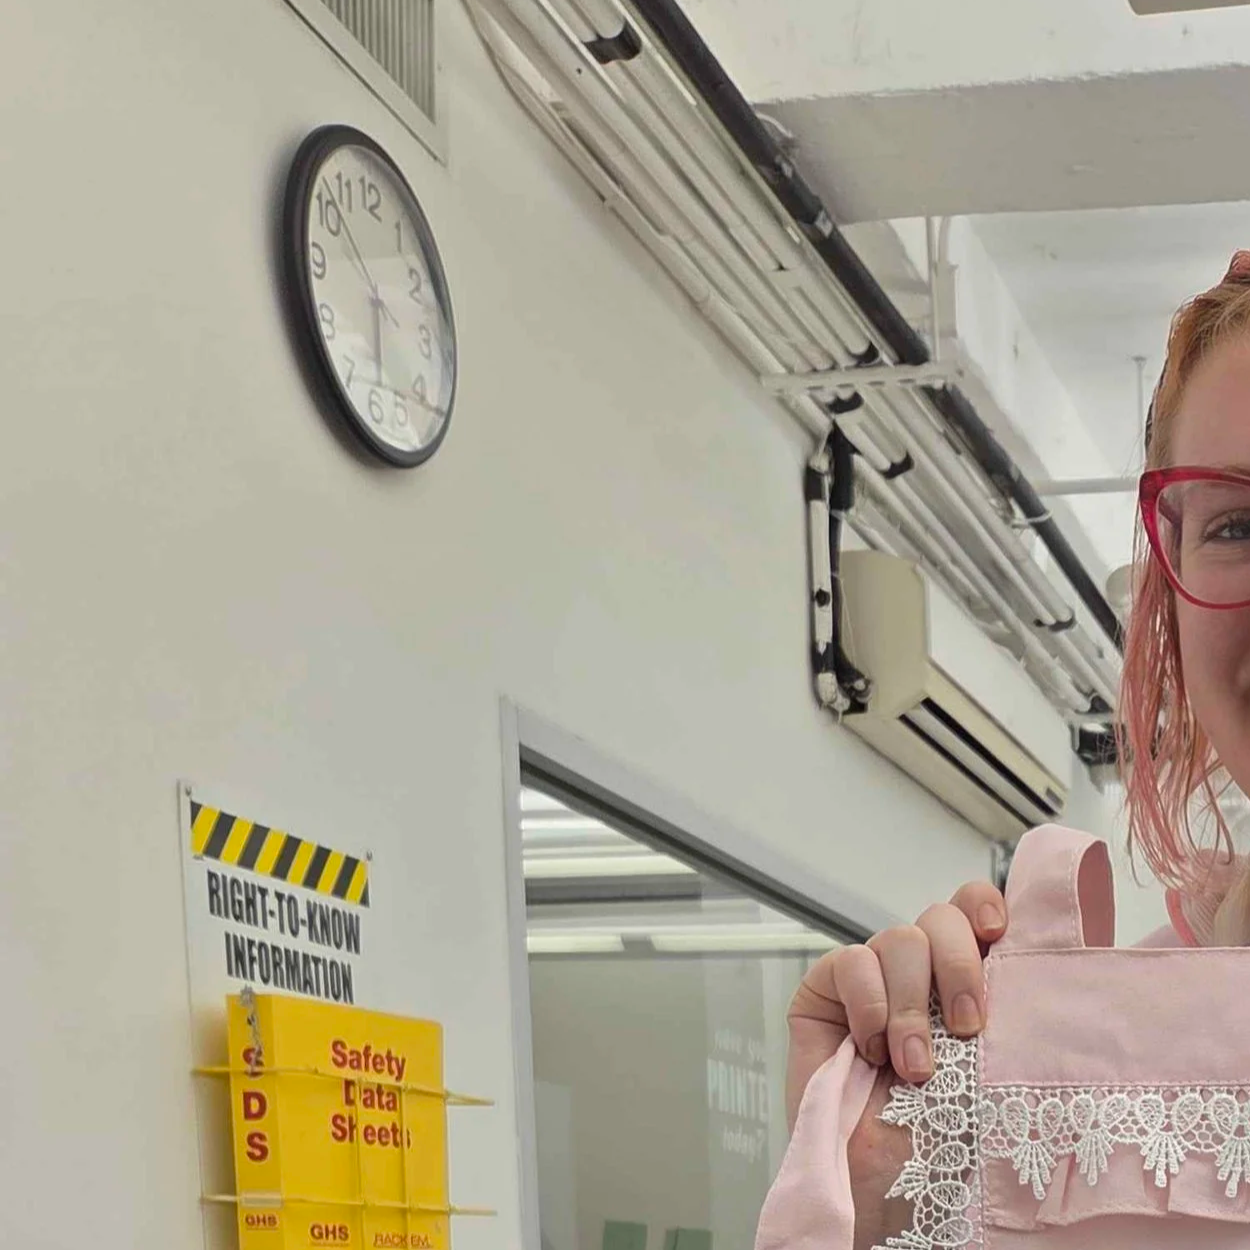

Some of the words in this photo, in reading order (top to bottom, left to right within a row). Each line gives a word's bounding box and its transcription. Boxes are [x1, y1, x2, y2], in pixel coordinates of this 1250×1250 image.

[336, 171, 353, 214] 11
[359, 175, 382, 223] 12
[316, 191, 342, 238] 10
[395, 221, 403, 255] 1
[311, 241, 327, 280] 9
[408, 267, 423, 304] 2
[419, 323, 432, 360] 3
[343, 353, 356, 388] 7
[412, 373, 427, 404] 4
[368, 389, 385, 425] 6
[207, 868, 361, 956] RIGHT-TO-KNOW
[224, 931, 355, 1006] INFORMATION
[331, 1039, 406, 1082] Safety
[344, 1079, 397, 1112] Data
[310, 1224, 349, 1241] GHS
